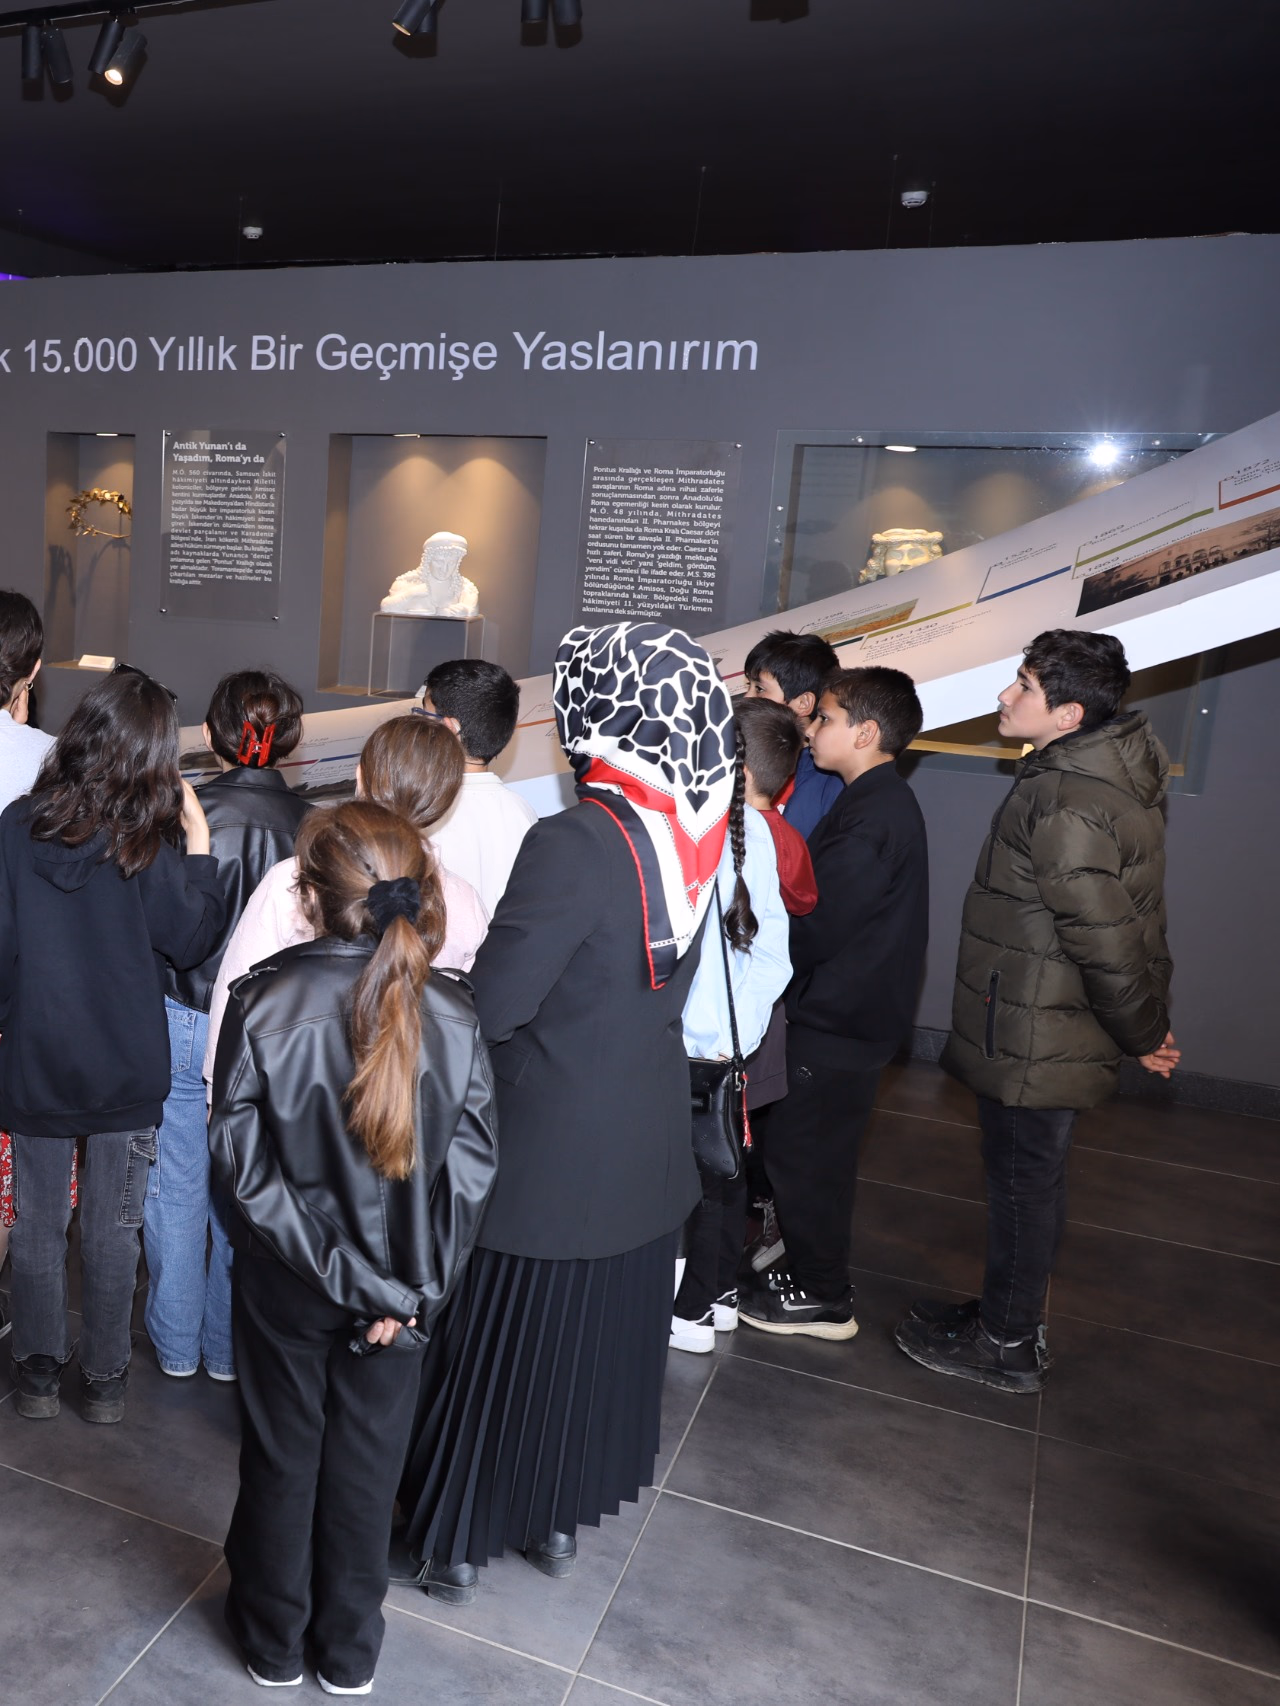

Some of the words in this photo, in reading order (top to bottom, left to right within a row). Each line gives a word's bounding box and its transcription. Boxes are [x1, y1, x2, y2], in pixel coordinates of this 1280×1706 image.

[23, 335, 138, 374] 15.000
[149, 334, 237, 372] Yıllık
[250, 333, 304, 371] Bir
[316, 332, 498, 381] Geçmişe
[513, 331, 759, 372] Yaslanırım
[173, 441, 197, 450] Antik
[199, 442, 233, 450] Yunan'ı
[235, 442, 247, 451] da
[173, 453, 213, 463] Yaşadım,
[215, 454, 251, 465] Roma'yı
[253, 454, 265, 463] da
